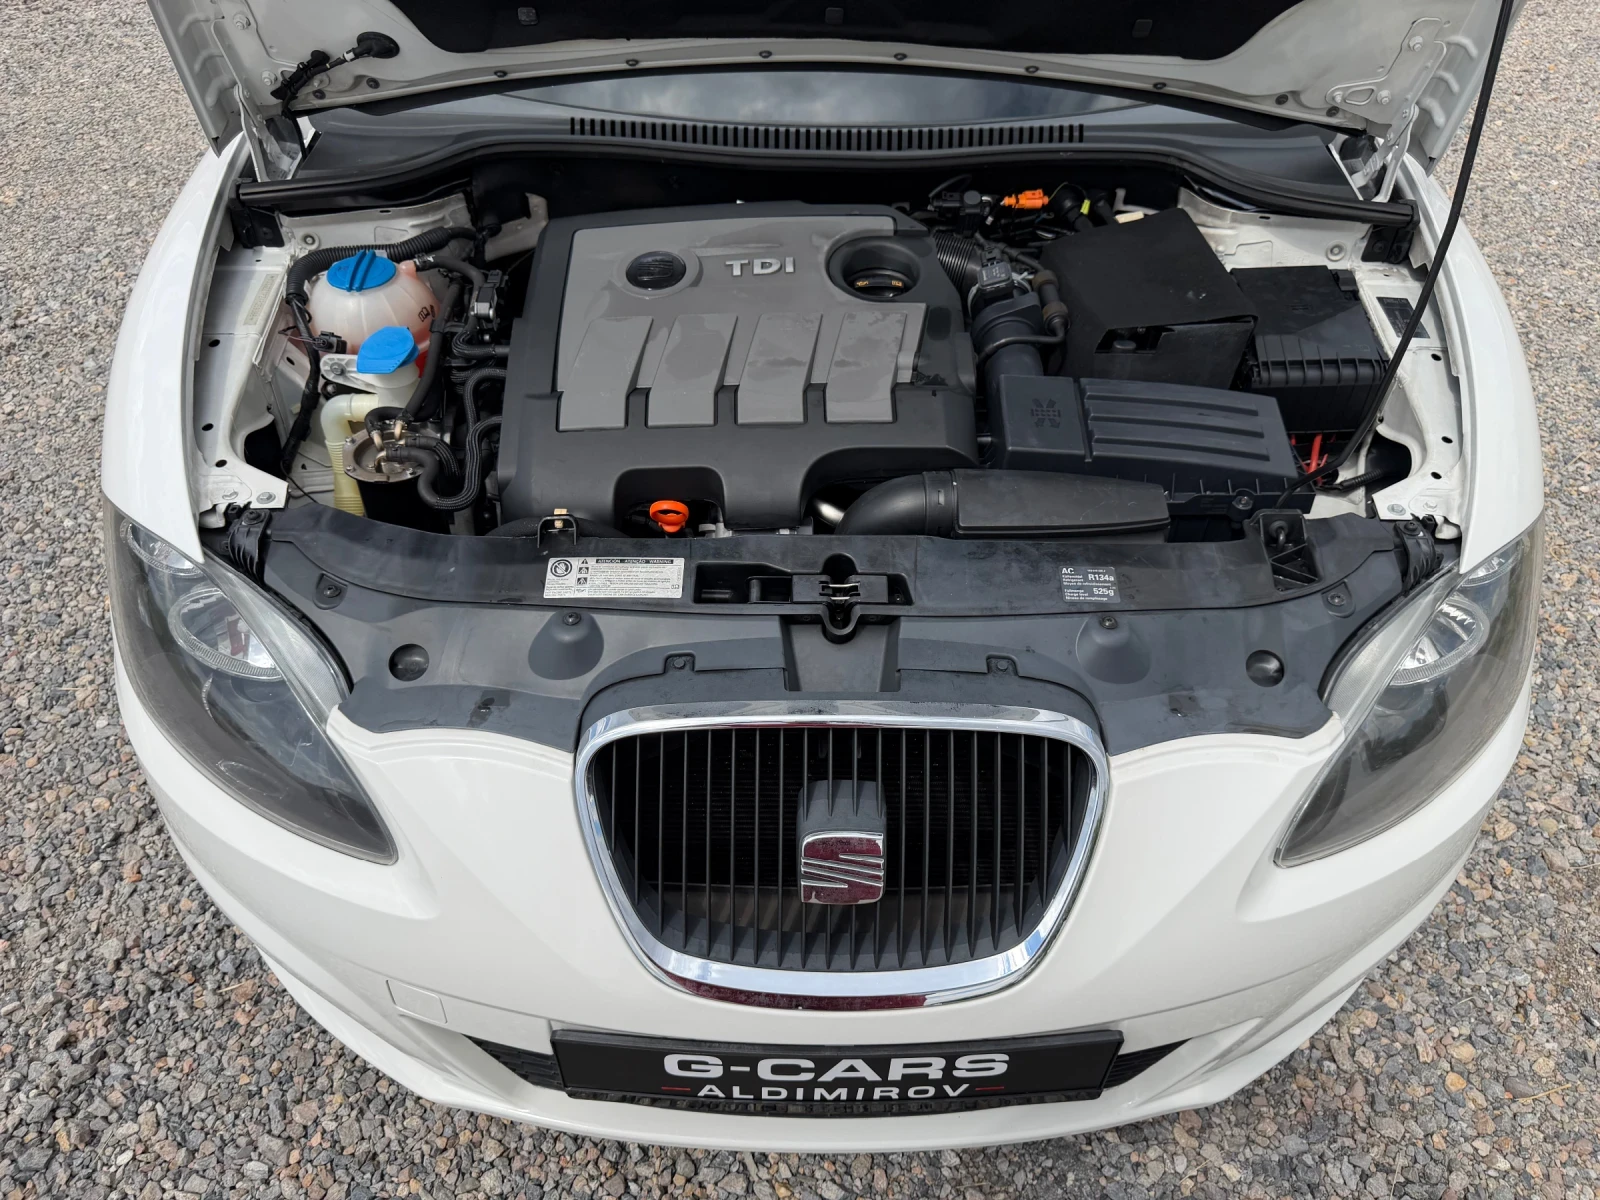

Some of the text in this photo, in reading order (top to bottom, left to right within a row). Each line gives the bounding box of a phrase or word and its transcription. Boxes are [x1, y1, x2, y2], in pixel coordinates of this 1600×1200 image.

[725, 257, 794, 276] TDI
[1093, 588, 1115, 596] 525g
[663, 1053, 1010, 1082] G-CARS
[697, 1083, 970, 1101] ALDIMIROV
